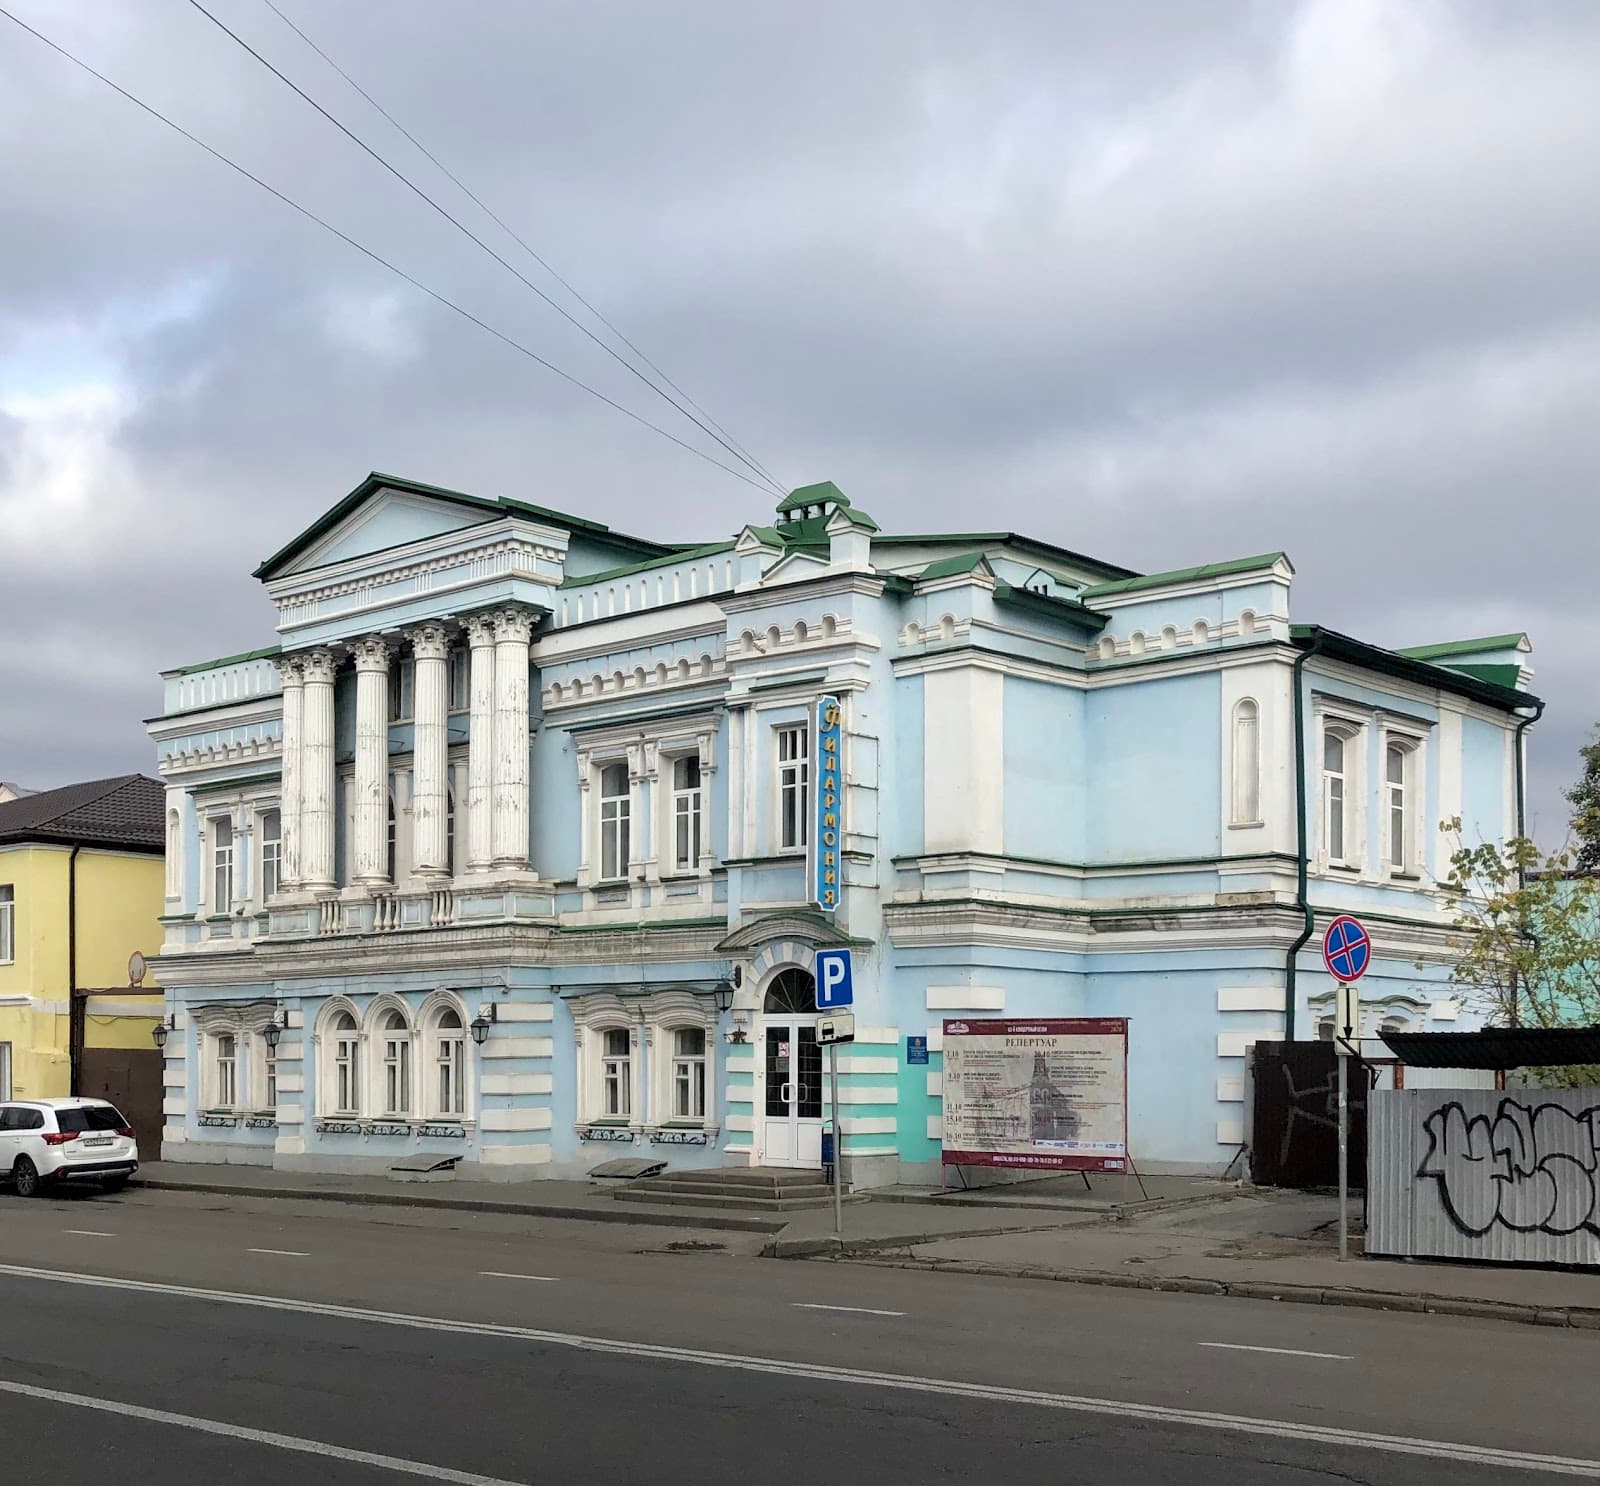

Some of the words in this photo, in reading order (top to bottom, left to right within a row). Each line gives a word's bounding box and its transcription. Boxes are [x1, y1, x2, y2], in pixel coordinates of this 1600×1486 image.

[819, 703, 841, 905] ФИЛАРМОНИЯ
[823, 956, 846, 1001] P
[1005, 1038, 1058, 1047] РЕПЕРТУАР
